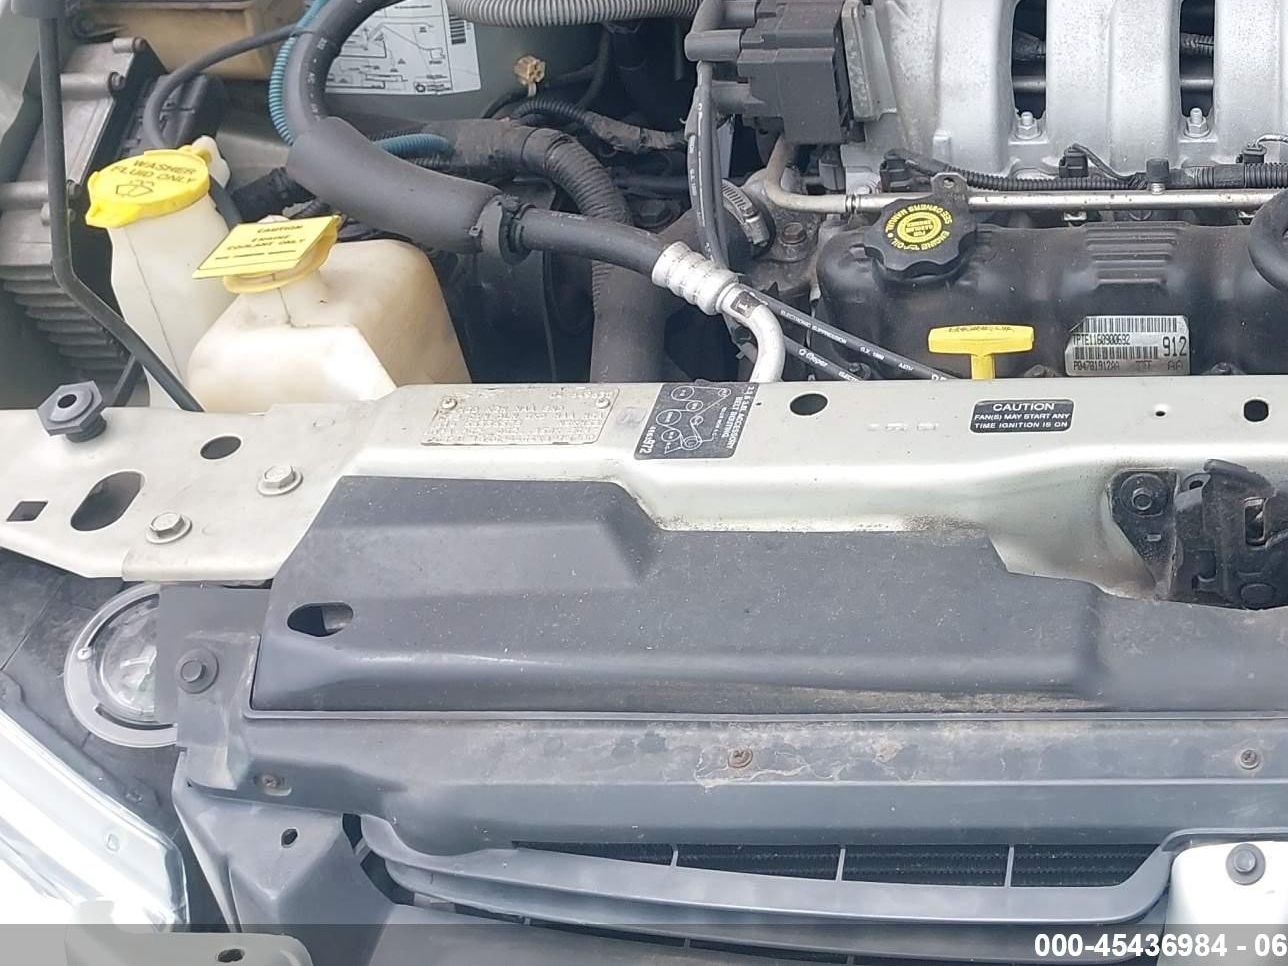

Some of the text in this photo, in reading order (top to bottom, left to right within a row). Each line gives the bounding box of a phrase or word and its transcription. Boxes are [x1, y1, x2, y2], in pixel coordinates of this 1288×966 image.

[110, 165, 198, 184] FLUID ONLY
[132, 159, 198, 175] WASHER
[941, 210, 953, 224] SEE
[891, 230, 950, 251] ENGINE OIL
[1162, 336, 1187, 357] 912
[993, 403, 1055, 412] CAUTION
[720, 396, 743, 437] BELT ROUTING
[974, 413, 1003, 421] FAN(S)
[1004, 413, 1023, 421] MAY
[1052, 412, 1071, 420] ANY
[726, 413, 744, 448] ACCESSORY
[975, 422, 997, 430] TIME
[999, 421, 1040, 429] IGNITION
